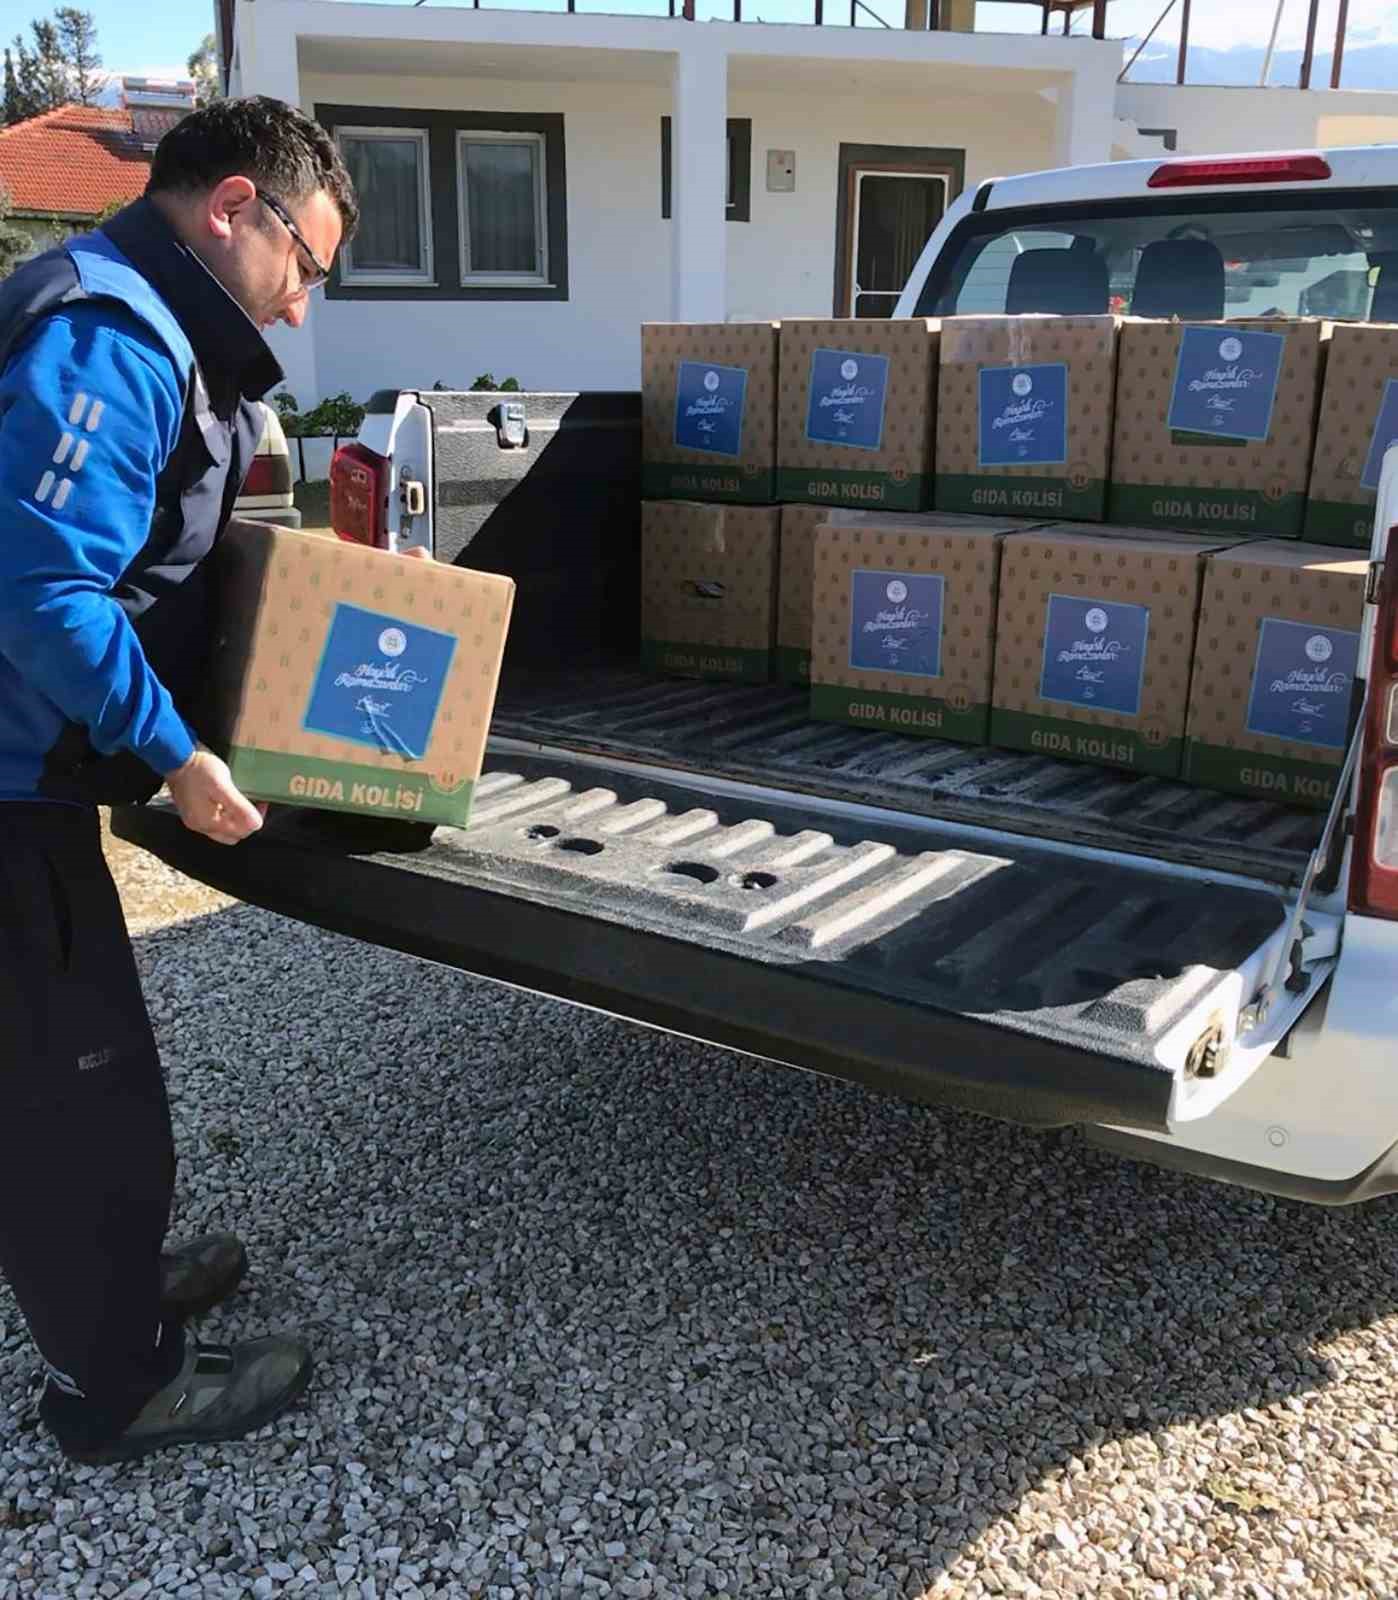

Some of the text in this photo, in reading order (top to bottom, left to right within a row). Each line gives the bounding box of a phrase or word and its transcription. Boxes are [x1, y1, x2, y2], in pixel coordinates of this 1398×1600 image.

[808, 480, 839, 497] GIDA
[972, 488, 1008, 505] GIDA
[1152, 500, 1193, 518] GIDA
[849, 703, 942, 728] GIDA KOLİSİ
[1031, 730, 1134, 763] GIDA KOLİSİ
[288, 774, 424, 811] GIDA KOLİSİ
[1240, 768, 1334, 801] GIDA KOL
